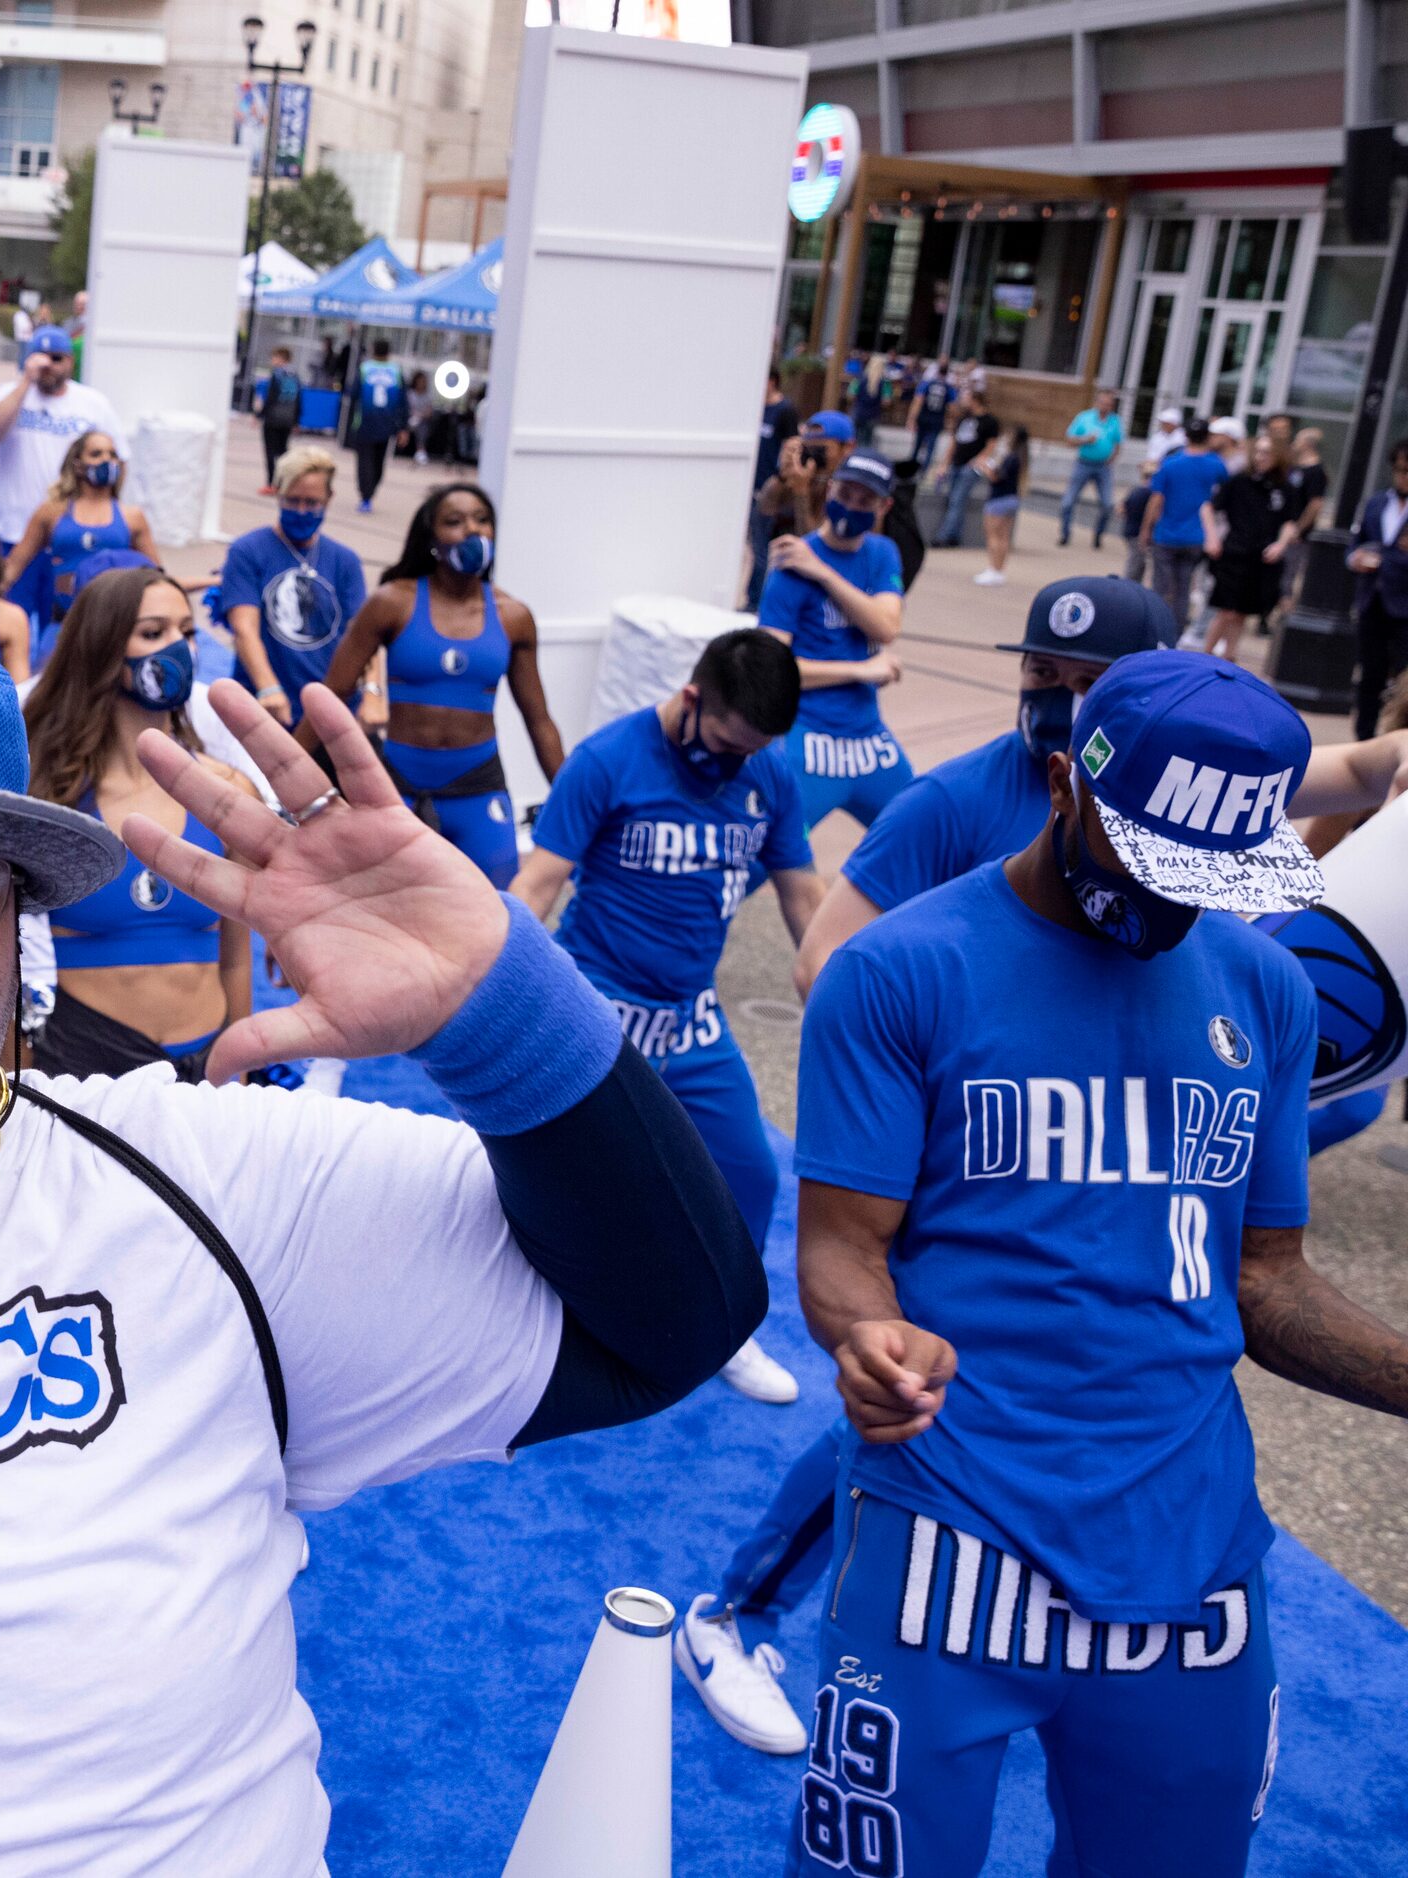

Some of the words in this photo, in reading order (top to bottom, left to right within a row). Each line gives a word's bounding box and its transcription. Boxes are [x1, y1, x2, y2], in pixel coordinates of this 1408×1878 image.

[804, 731, 899, 779] MAVS
[1157, 856, 1203, 869] MAVS
[1228, 849, 1311, 871] thirst
[1206, 881, 1264, 899] Sprite
[963, 1076, 1260, 1188] DALLAS
[835, 1655, 883, 1694] Est
[808, 1683, 900, 1799] 19
[801, 1770, 905, 1878] 80
